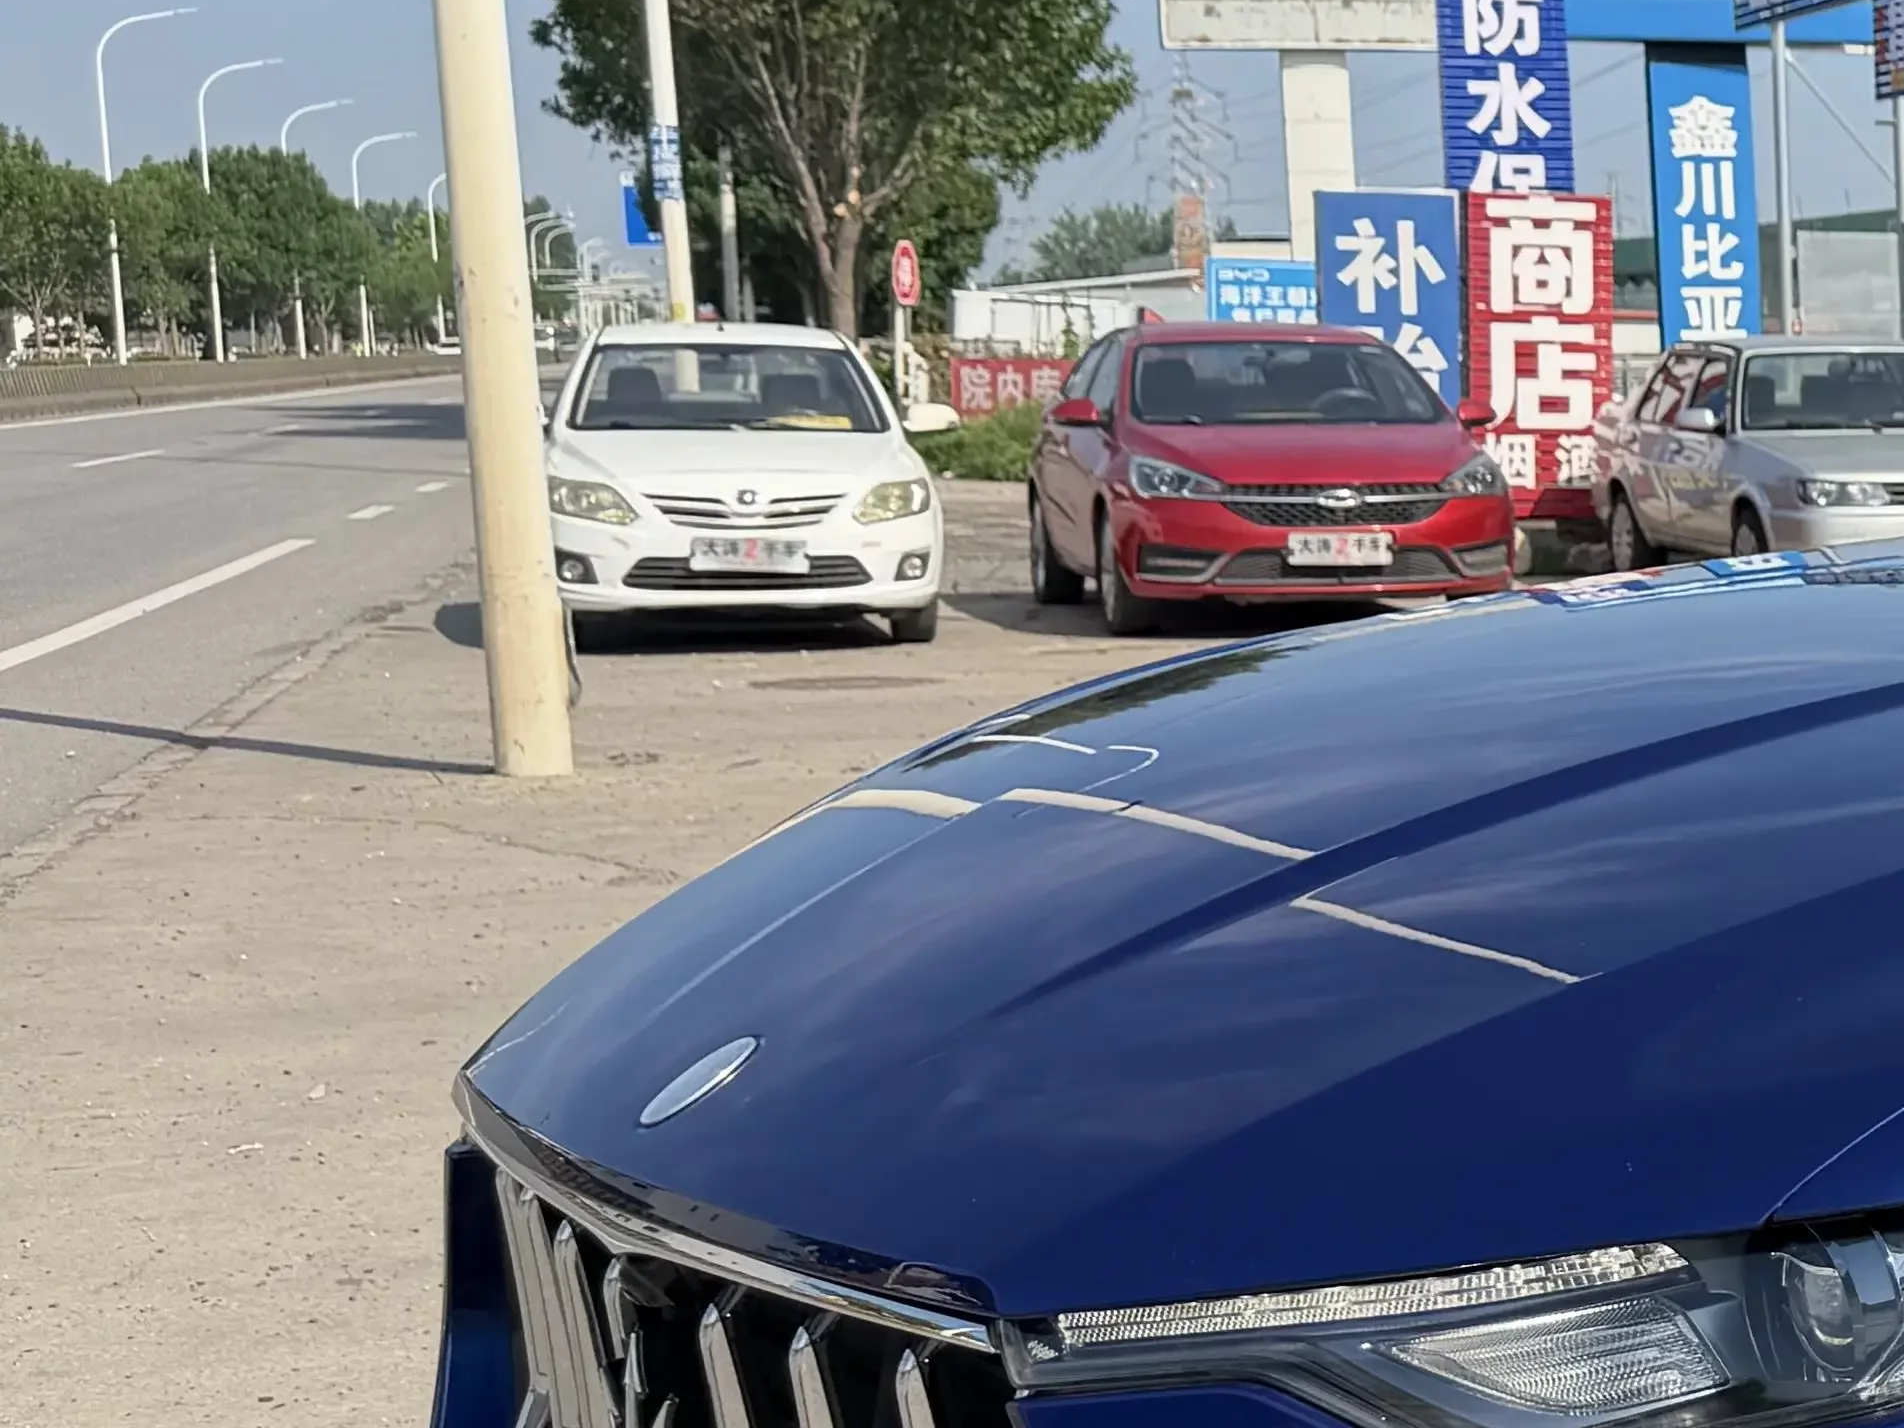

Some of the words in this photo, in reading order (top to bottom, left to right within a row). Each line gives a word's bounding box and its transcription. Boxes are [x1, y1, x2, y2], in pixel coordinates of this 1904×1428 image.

[1484, 196, 1598, 431] 商店
[1669, 95, 1748, 339] 鑫川比亚
